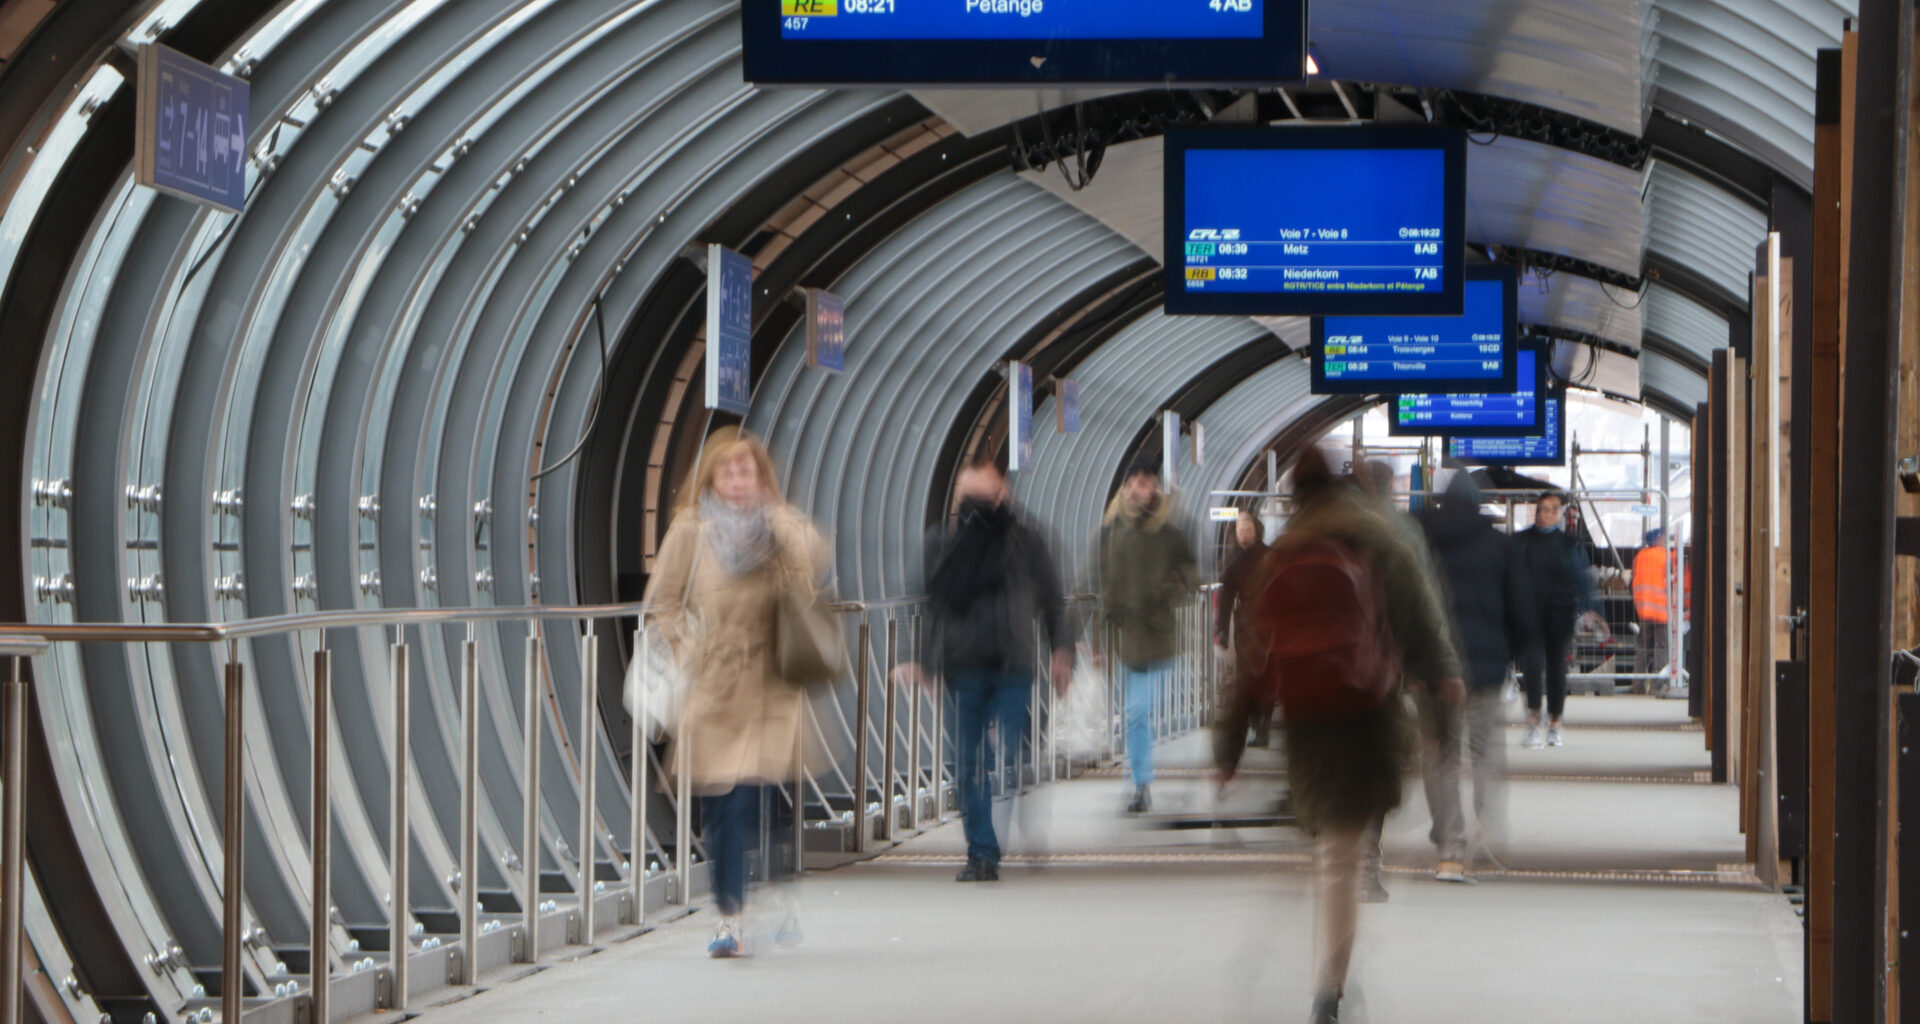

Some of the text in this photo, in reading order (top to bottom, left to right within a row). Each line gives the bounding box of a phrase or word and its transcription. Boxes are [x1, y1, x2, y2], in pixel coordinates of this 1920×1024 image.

[794, 0, 823, 13] RE
[844, 0, 895, 13] 08:21
[783, 17, 809, 30] 457
[1280, 229, 1301, 239] Voie
[1303, 229, 1309, 239] 7
[1318, 229, 1339, 239] Voie
[1341, 229, 1348, 239] 8
[1188, 243, 1212, 254] TER
[1218, 243, 1248, 255] 08:39
[1283, 244, 1309, 255] Metz
[1192, 268, 1209, 279] RB
[1218, 267, 1248, 280] 08:32
[1283, 268, 1339, 279] Niederkorn
[1347, 282, 1385, 290] Niederkorn
[1387, 282, 1394, 290] et
[1396, 282, 1425, 291] Pétange
[1393, 345, 1435, 355] Troisvierges
[1393, 362, 1426, 371] Thionville
